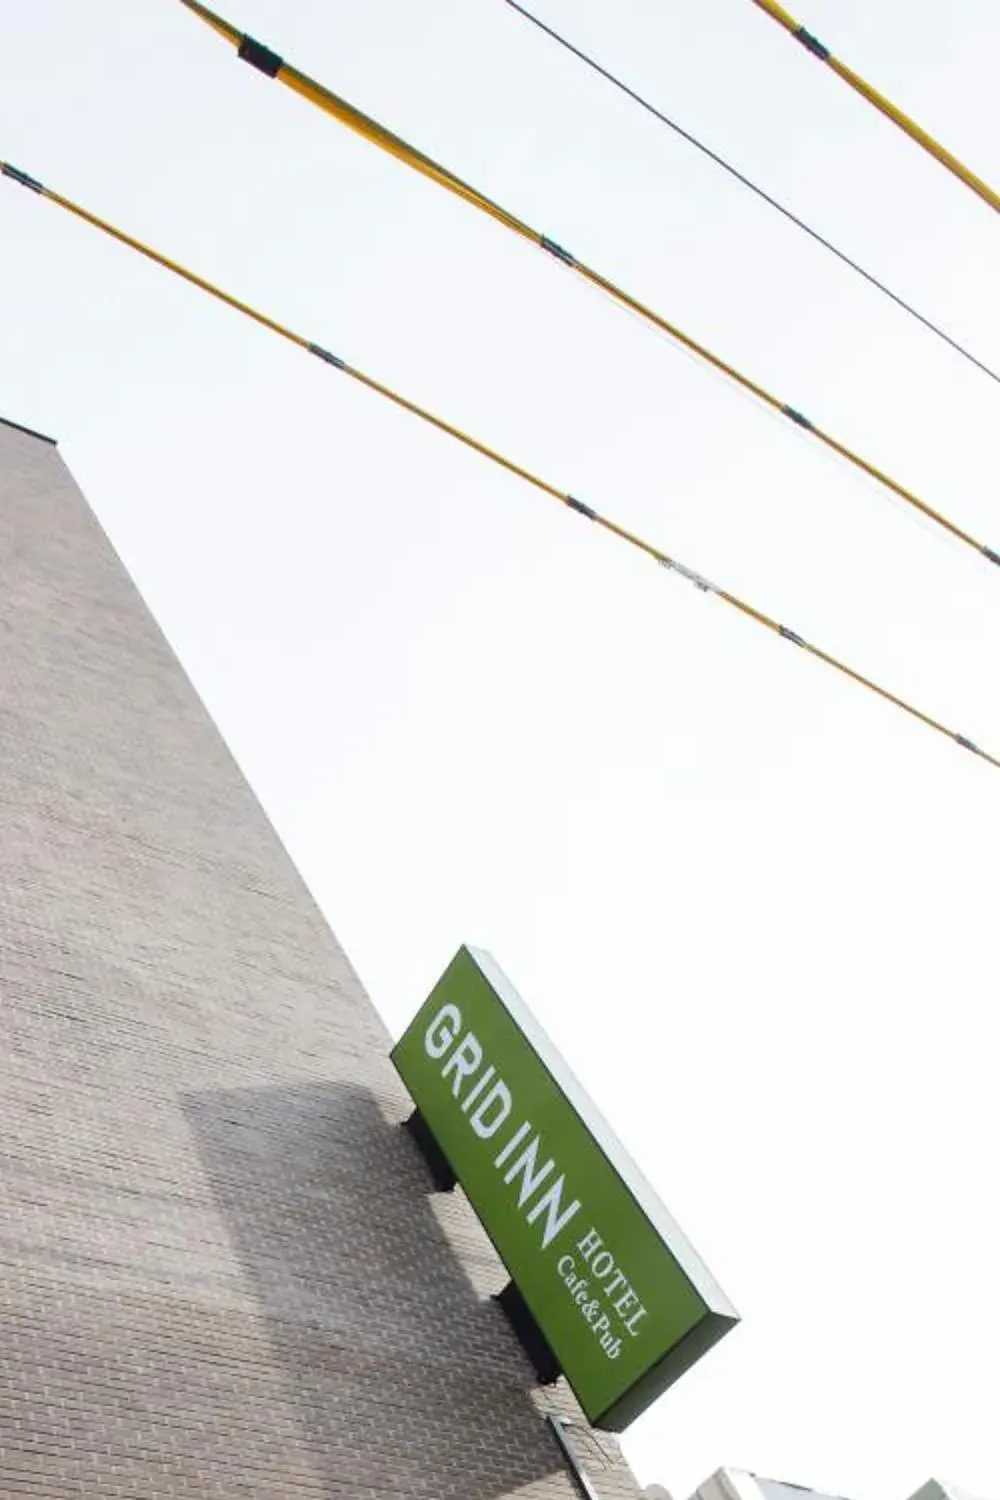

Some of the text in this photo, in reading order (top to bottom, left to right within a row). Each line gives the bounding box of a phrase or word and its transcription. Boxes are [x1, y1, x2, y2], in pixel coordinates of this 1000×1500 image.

[423, 1003, 582, 1251] GRID INN
[556, 1255, 622, 1361] Cafe&Pub
[577, 1227, 649, 1337] HOTEL
